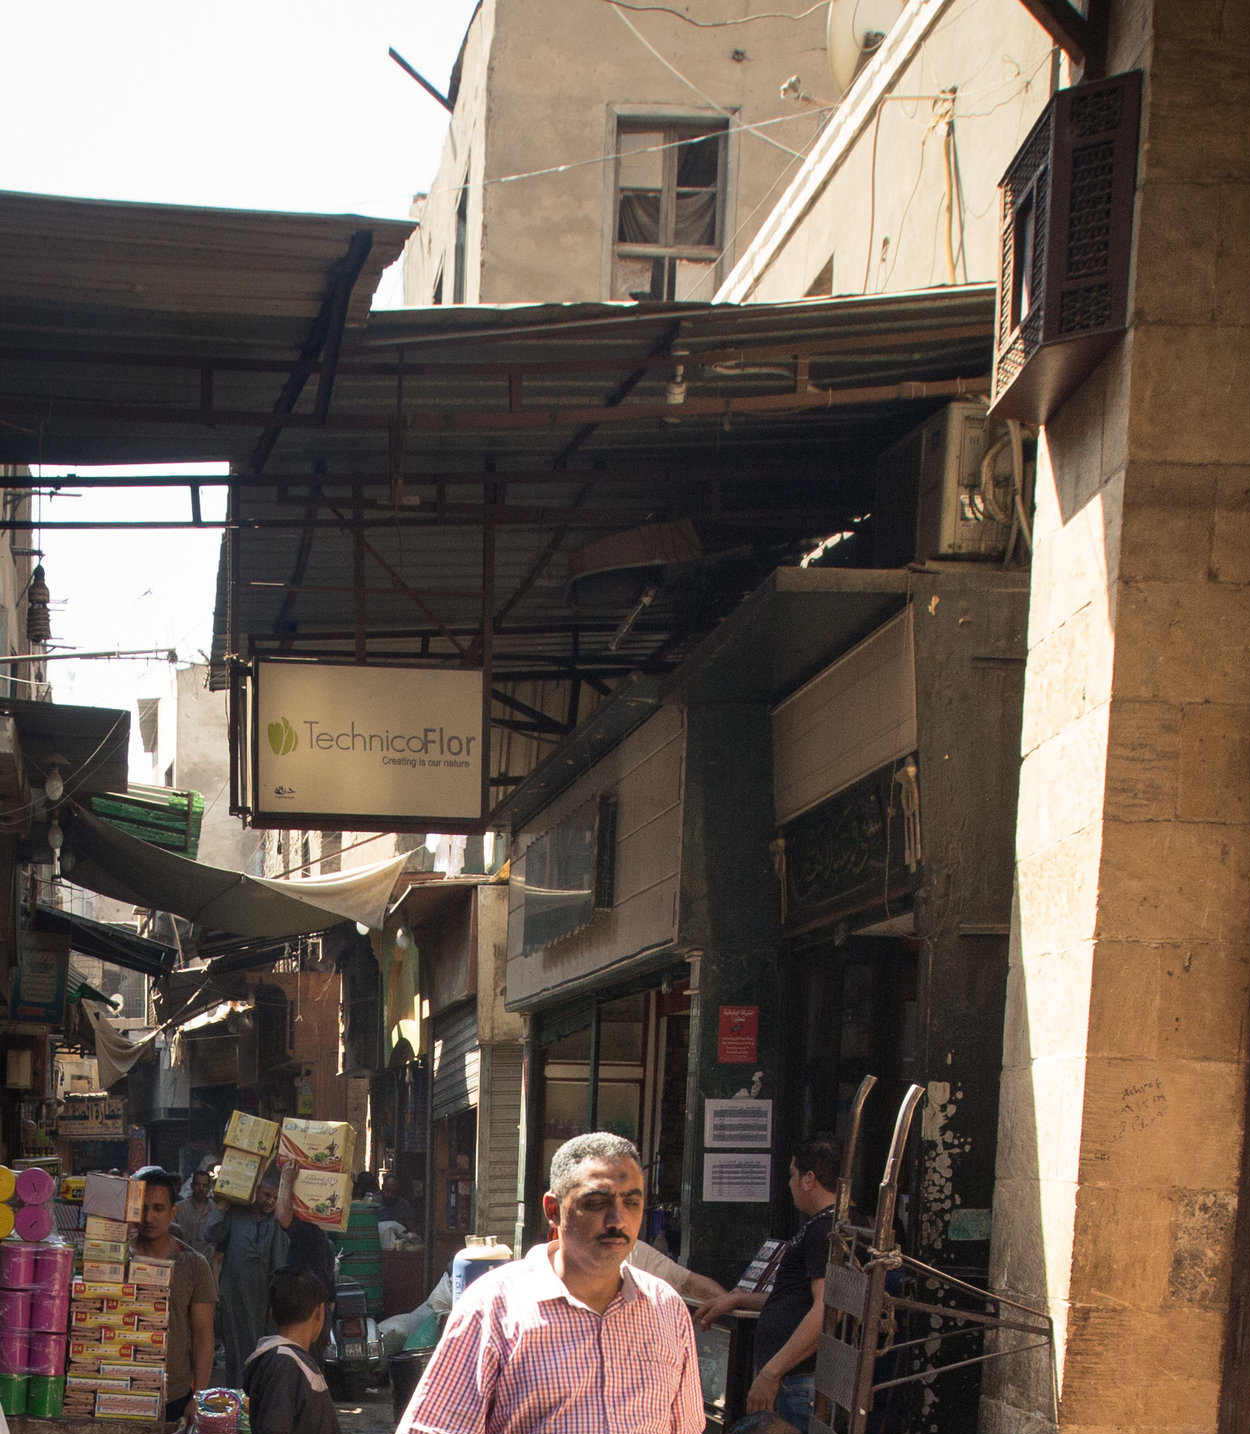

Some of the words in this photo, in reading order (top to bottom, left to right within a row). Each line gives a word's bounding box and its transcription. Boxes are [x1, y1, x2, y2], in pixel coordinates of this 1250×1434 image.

[303, 721, 476, 756] TechnicoFlor
[382, 756, 417, 768] Creating
[419, 758, 426, 767] is
[444, 760, 470, 768] nature
